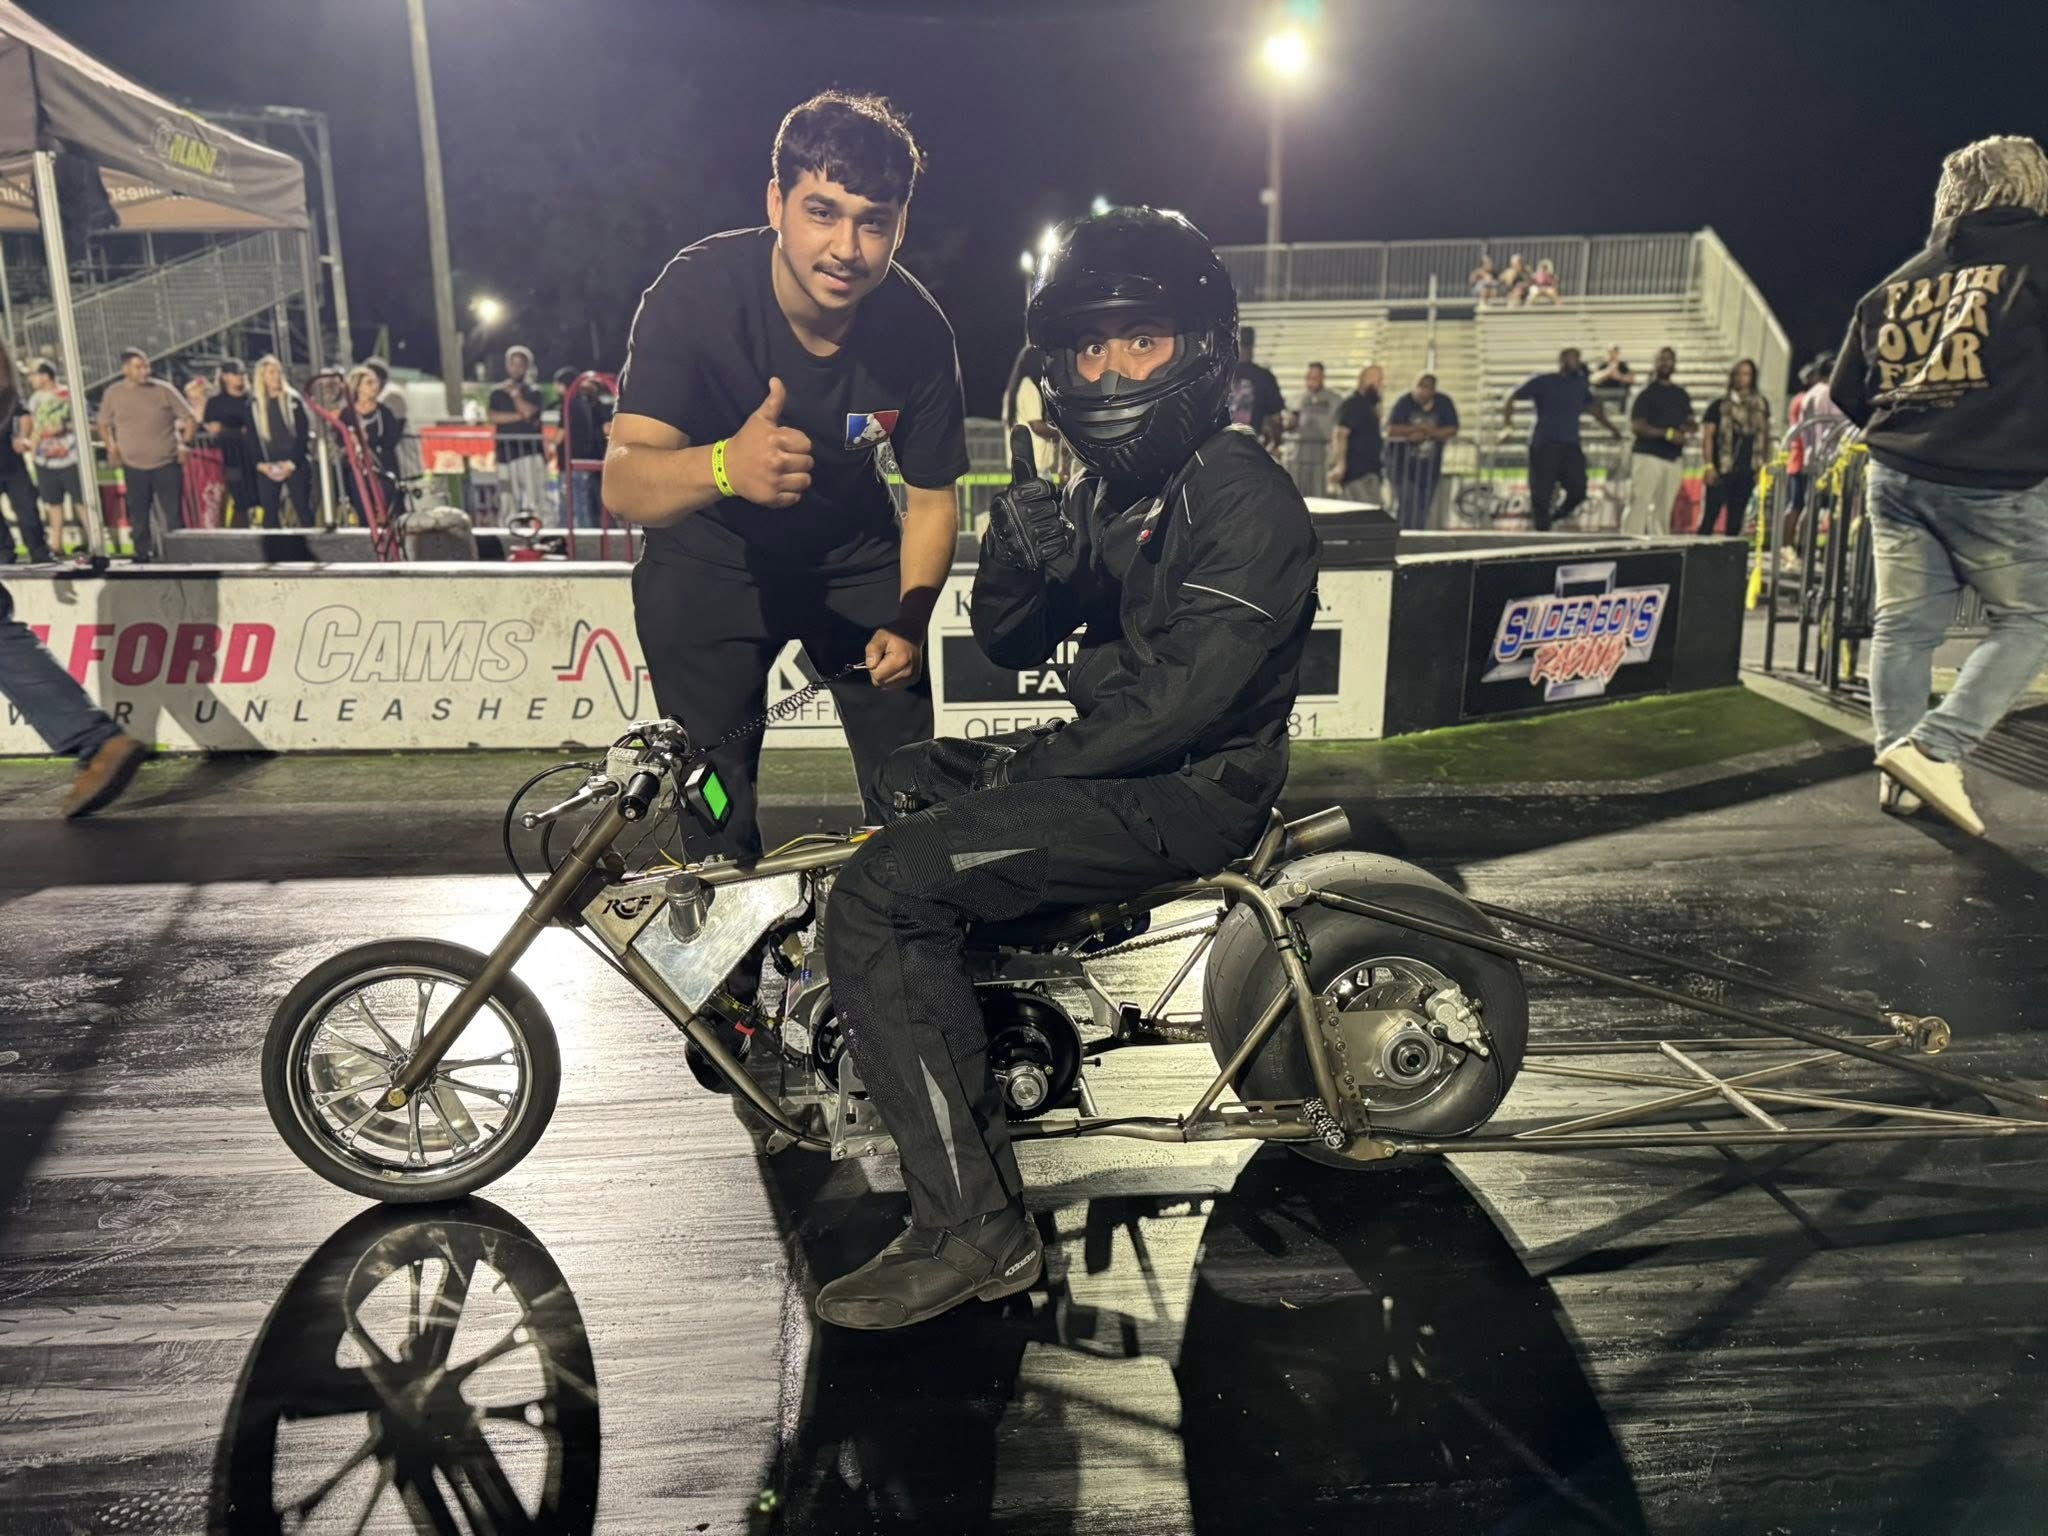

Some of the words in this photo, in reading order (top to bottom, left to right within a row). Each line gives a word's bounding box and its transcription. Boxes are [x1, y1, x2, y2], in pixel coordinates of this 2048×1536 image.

[1884, 264, 2007, 321] FAITH
[1878, 290, 1989, 362] OVER
[1878, 332, 1985, 390] FEAR
[294, 604, 535, 683] CAMS
[1531, 637, 1628, 685] RACING
[195, 696, 594, 723] UNLEASHED
[602, 895, 652, 920] RCF
